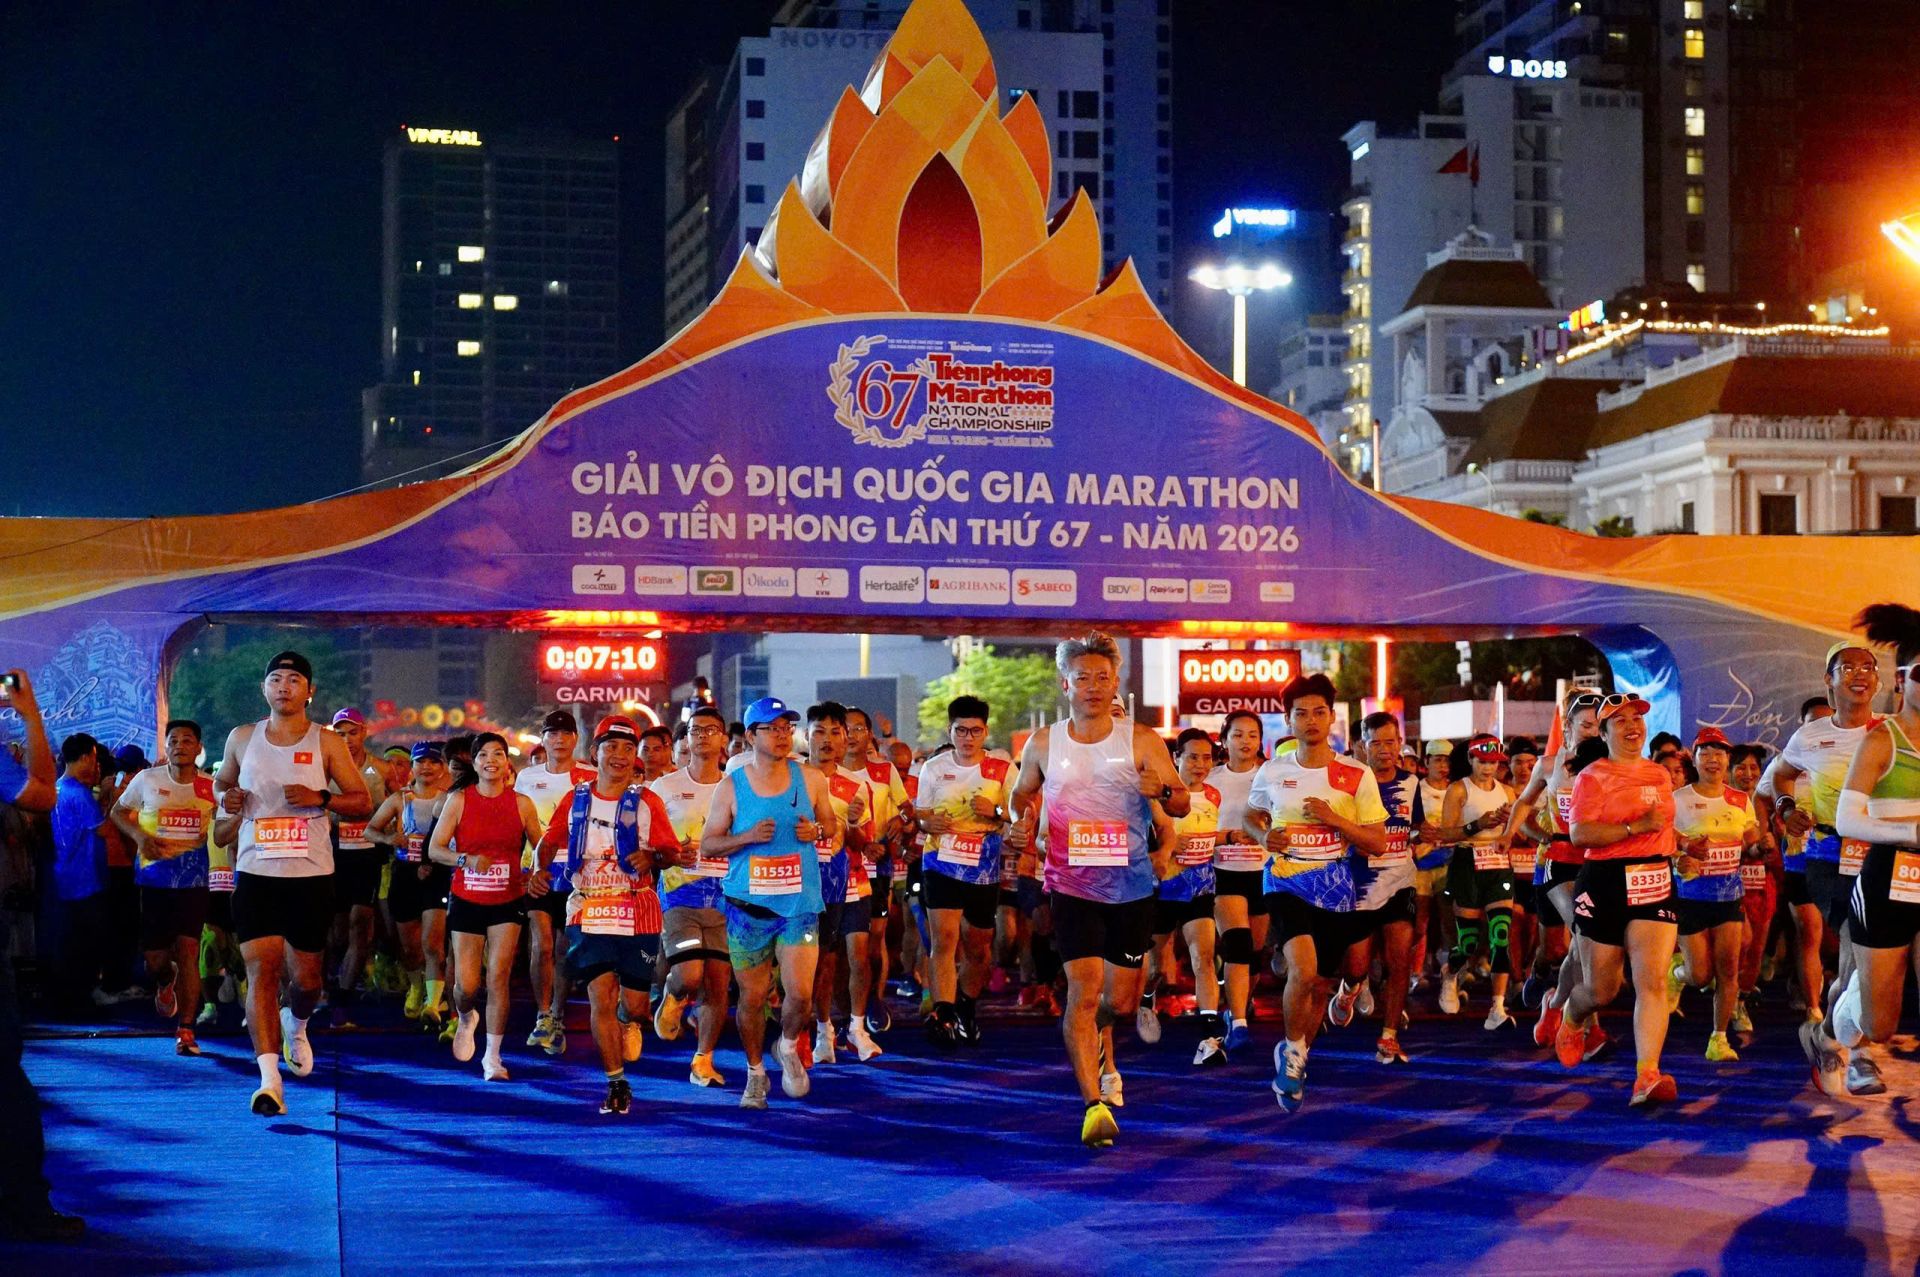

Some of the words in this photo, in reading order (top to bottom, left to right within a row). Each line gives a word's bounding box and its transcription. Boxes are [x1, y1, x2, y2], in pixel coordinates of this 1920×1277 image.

[1510, 59, 1567, 78] BOSS
[857, 360, 920, 429] 67
[928, 382, 1053, 405] Marathon
[928, 405, 1010, 417] NATIONAL
[928, 417, 1052, 431] CHAMPIONSHIP
[571, 450, 660, 496] GIẢI
[671, 453, 734, 497] VÔ
[745, 464, 842, 506] ĐỊCH
[853, 454, 970, 503] QUỐC
[980, 470, 1054, 504] GIA
[1065, 472, 1299, 509] MARATHON
[571, 502, 650, 539] BÁO
[659, 500, 737, 540] TIỀN
[746, 513, 877, 543] PHONG
[886, 505, 958, 544] LẦN
[967, 511, 1042, 547] THỨ
[1049, 520, 1091, 548] 67
[1100, 534, 1114, 544] -
[1123, 515, 1208, 550] NĂM
[1217, 524, 1300, 552] 2026
[638, 576, 673, 585] HDBank
[865, 579, 915, 592] Herbalife
[941, 581, 1007, 592] AGRIBANK
[1034, 582, 1072, 593] SABECO
[1107, 584, 1131, 594] BIDV
[546, 646, 657, 671] 0:07:10
[1184, 659, 1289, 682] 0:00:00
[556, 687, 650, 702] GARMIN
[1196, 697, 1285, 713] GARMIN
[161, 816, 193, 826] 81793
[258, 829, 299, 840] 80730
[1072, 832, 1118, 845] 80435
[1290, 833, 1332, 845] 80071
[467, 867, 502, 876] 850
[753, 865, 793, 877] 81552
[1631, 872, 1668, 887] 83339
[586, 906, 627, 918] 80636
